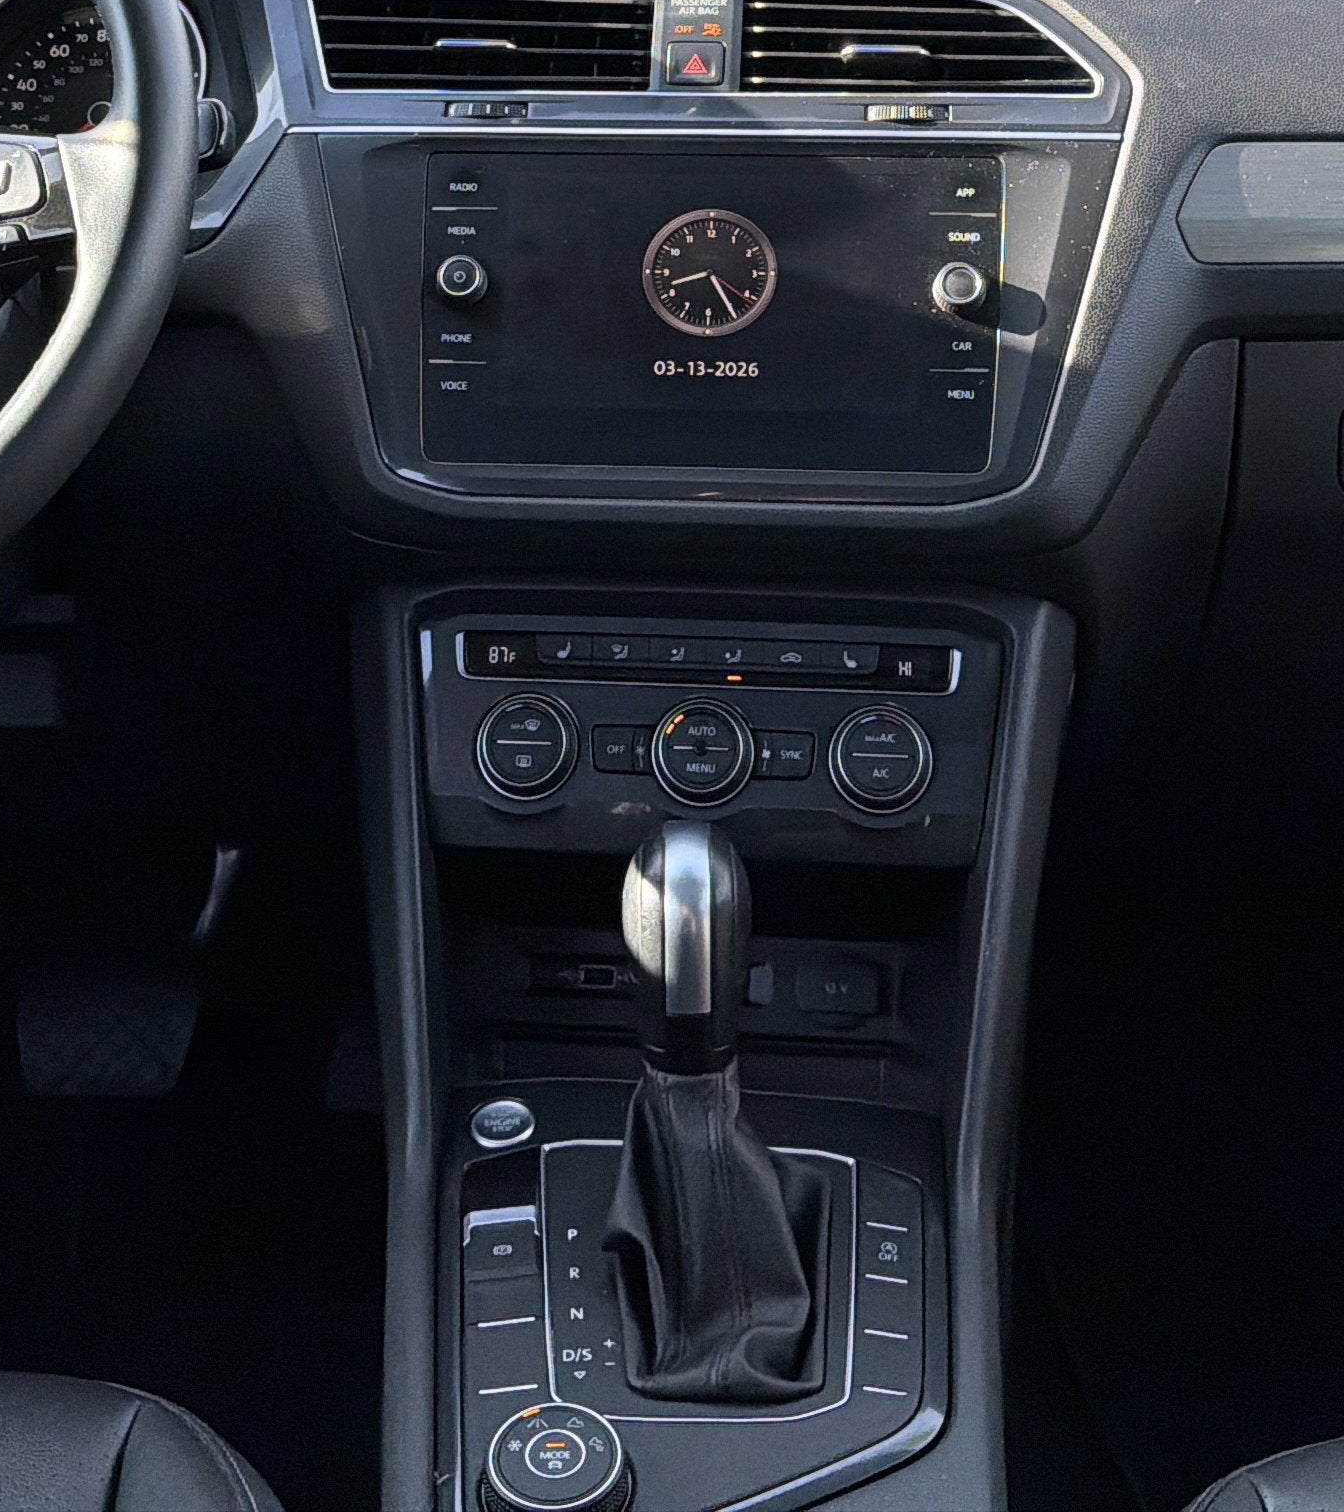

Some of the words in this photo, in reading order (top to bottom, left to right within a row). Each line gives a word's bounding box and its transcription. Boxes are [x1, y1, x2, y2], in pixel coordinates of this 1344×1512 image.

[679, 7, 696, 16] AIR
[697, 7, 720, 16] BAG
[674, 25, 696, 34] OFF
[75, 33, 89, 43] 70
[49, 44, 70, 58] 60
[33, 60, 46, 70] 50
[16, 78, 37, 92] 40
[11, 101, 24, 111] 30
[449, 182, 478, 191] RADIO
[956, 187, 976, 197] APP
[447, 226, 476, 235] MEDIA
[948, 231, 981, 242] SOUND
[441, 334, 472, 343] PHONE
[952, 341, 972, 351] CAR
[653, 360, 759, 377] 03-13-2026
[440, 380, 469, 391] VOICE
[947, 389, 975, 400] MENU
[687, 727, 716, 737] AUTO
[606, 744, 626, 755] OFF
[780, 750, 804, 761] SYNC
[686, 763, 716, 774] MENU
[872, 768, 890, 779] A/C
[567, 1228, 578, 1241] P
[569, 1266, 581, 1280] R
[570, 1307, 584, 1320] N
[562, 1348, 593, 1363] D/S
[539, 1450, 572, 1460] MODE
